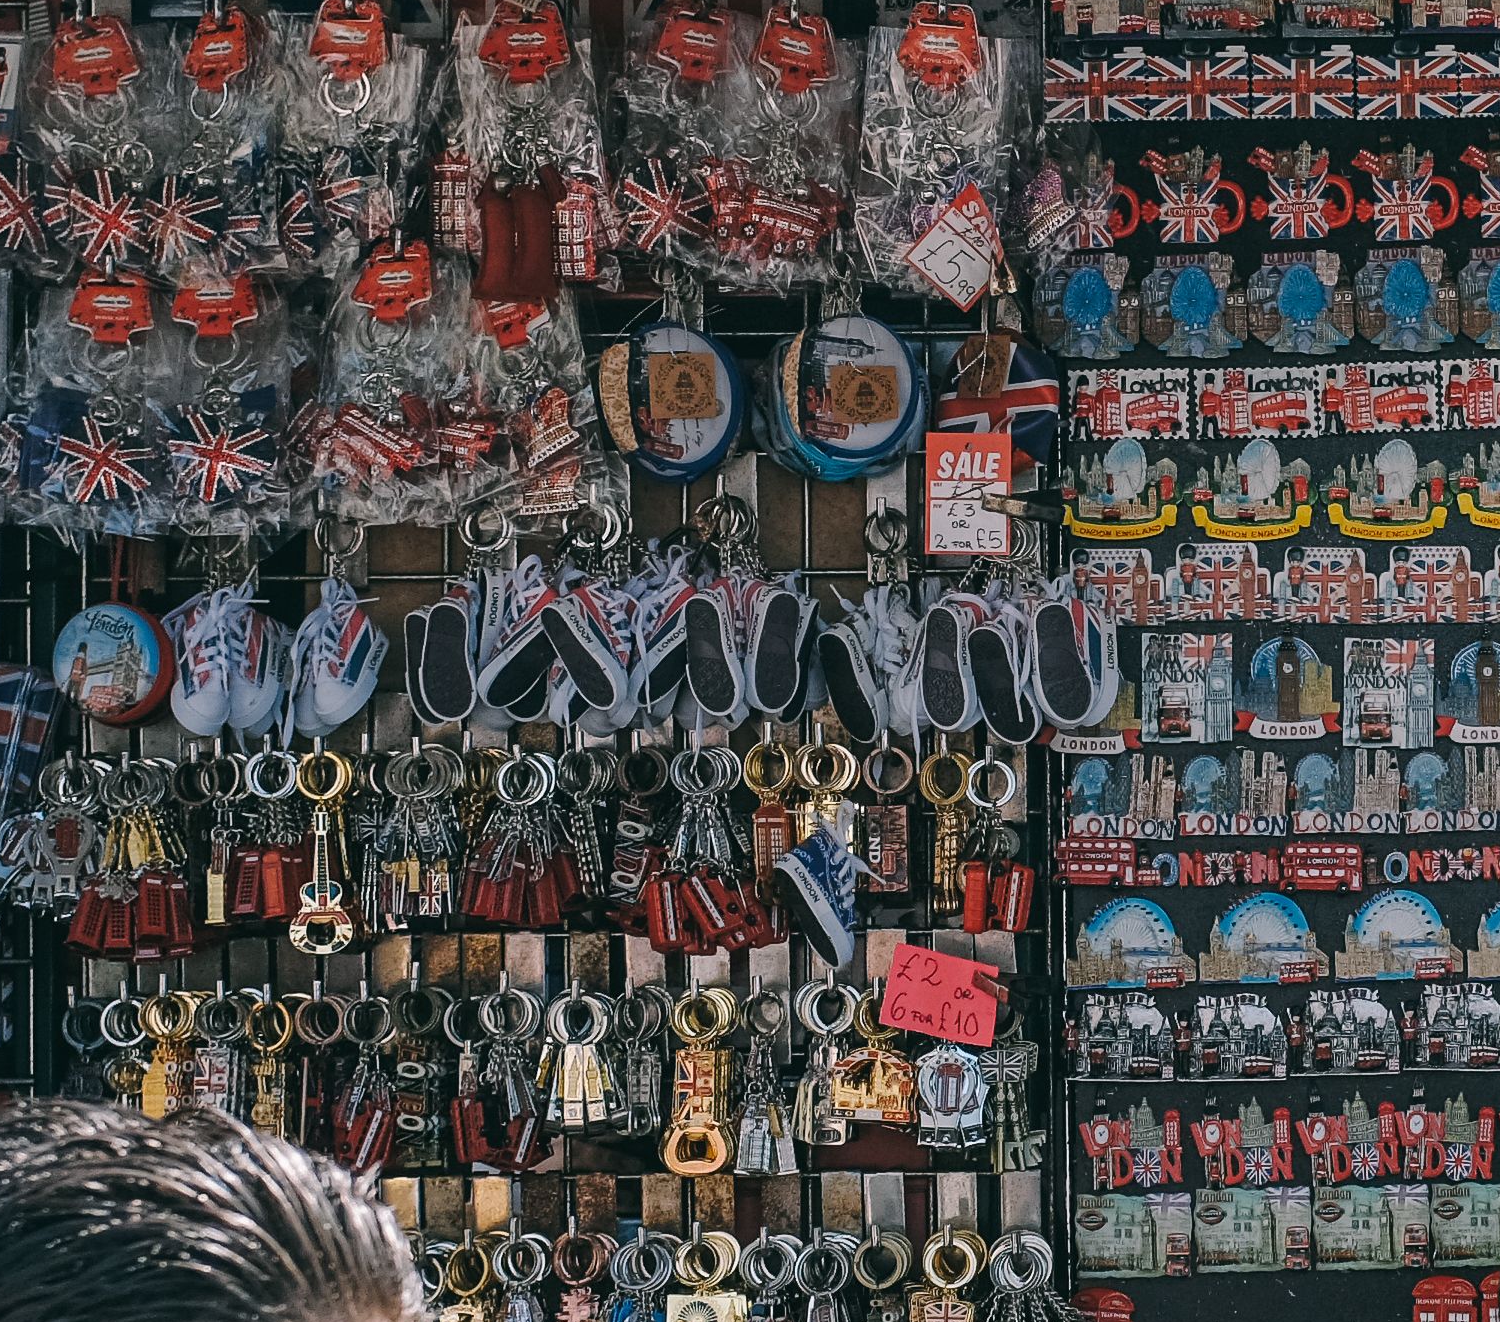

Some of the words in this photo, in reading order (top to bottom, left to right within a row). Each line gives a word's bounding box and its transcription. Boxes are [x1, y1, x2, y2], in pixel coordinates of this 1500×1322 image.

[918, 238, 976, 303] £5.99
[936, 450, 1000, 480] SALE
[946, 503, 977, 518] £3
[951, 519, 970, 529] OR
[1208, 526, 1247, 537] LONDON
[1249, 525, 1295, 538] ENGLAND
[934, 534, 948, 549] 2
[951, 540, 973, 550] FOR
[976, 528, 1003, 549] £5
[1260, 723, 1317, 738] LONDON
[1061, 738, 1116, 752] LONDON
[1180, 814, 1287, 836] LONDON
[894, 953, 942, 986] £2
[953, 987, 975, 1000] OR
[890, 992, 907, 1022] 6
[911, 1010, 934, 1027] FOR
[939, 1002, 980, 1037] £10
